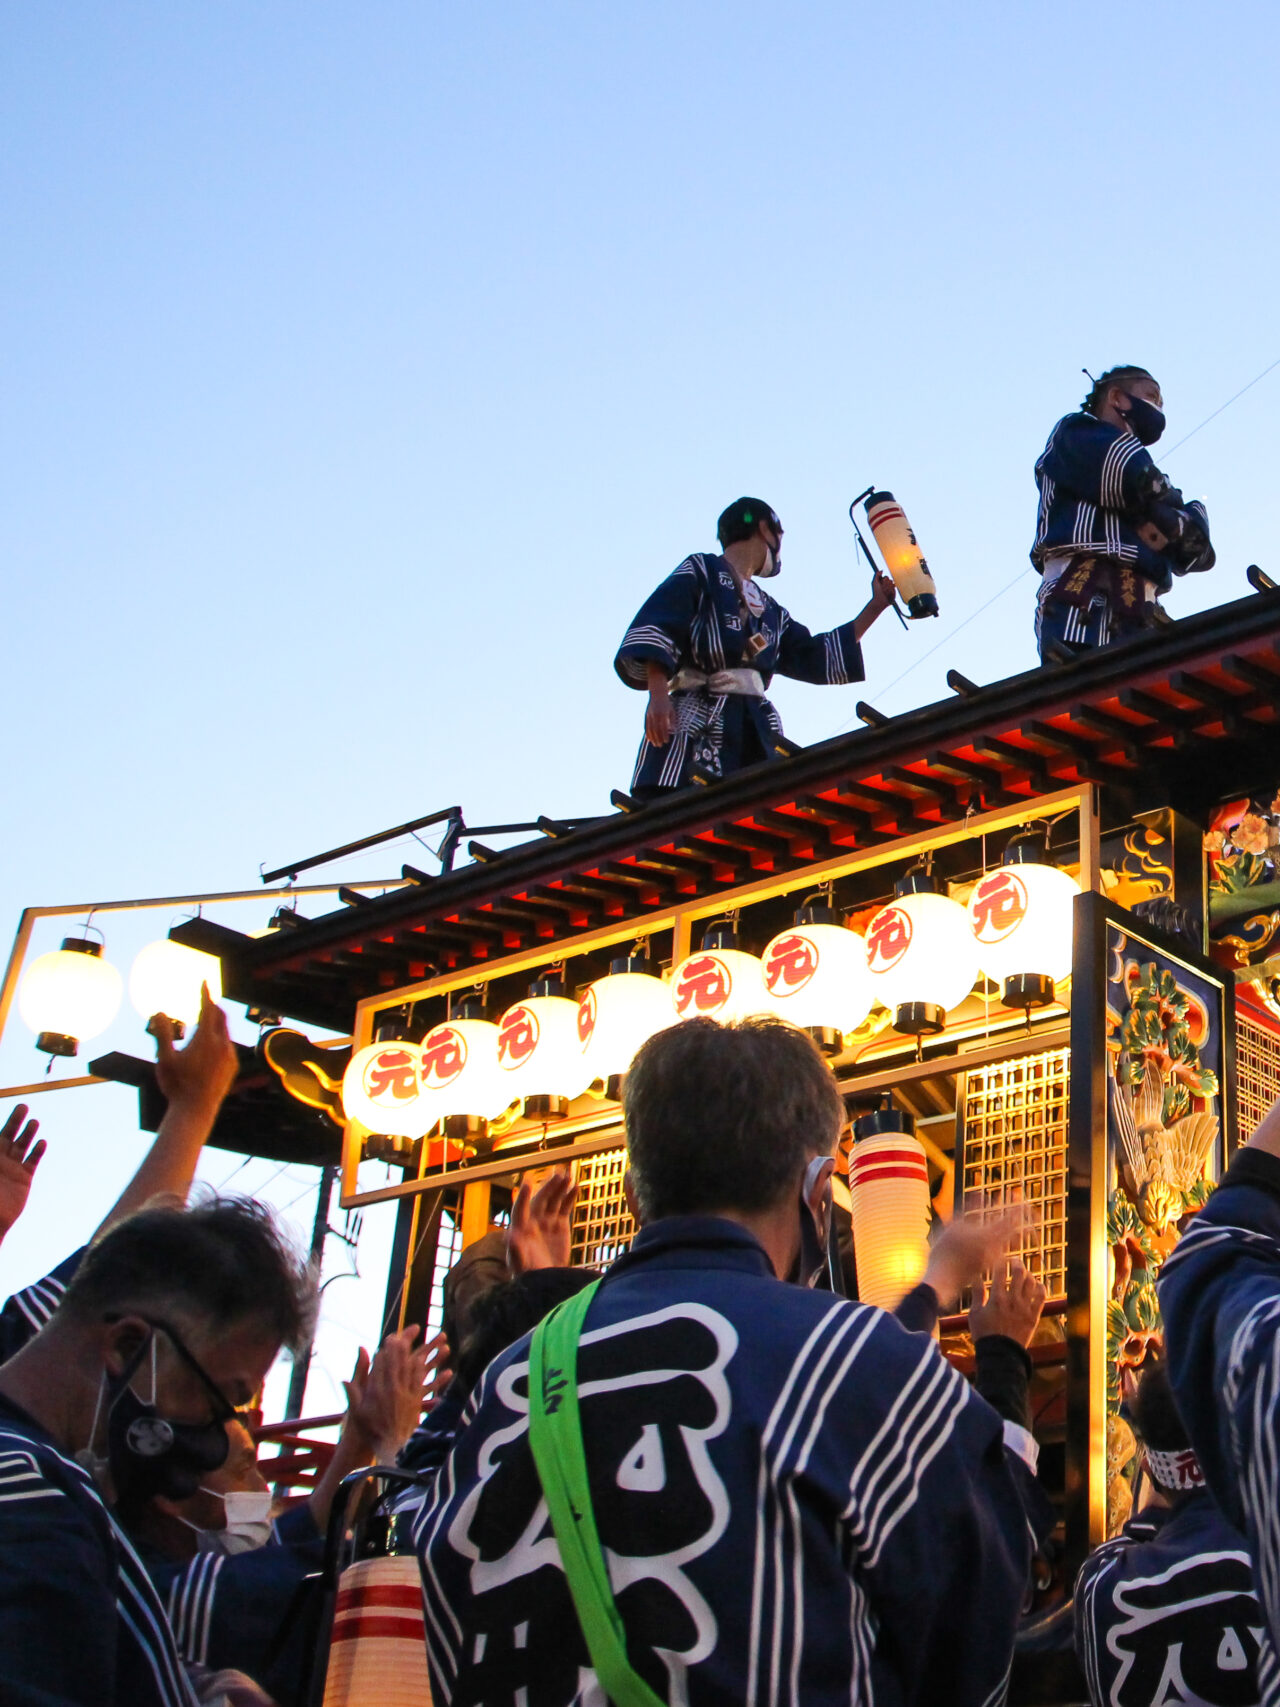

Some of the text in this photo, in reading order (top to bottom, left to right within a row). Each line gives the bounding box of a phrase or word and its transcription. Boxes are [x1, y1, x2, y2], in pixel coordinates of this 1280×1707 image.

[972, 873, 1026, 935] 元
[766, 937, 817, 989] 元
[867, 909, 909, 964] 元
[677, 957, 728, 1012] 元
[421, 1028, 465, 1082] 元
[498, 1009, 537, 1062] 元
[369, 1050, 420, 1100] 元
